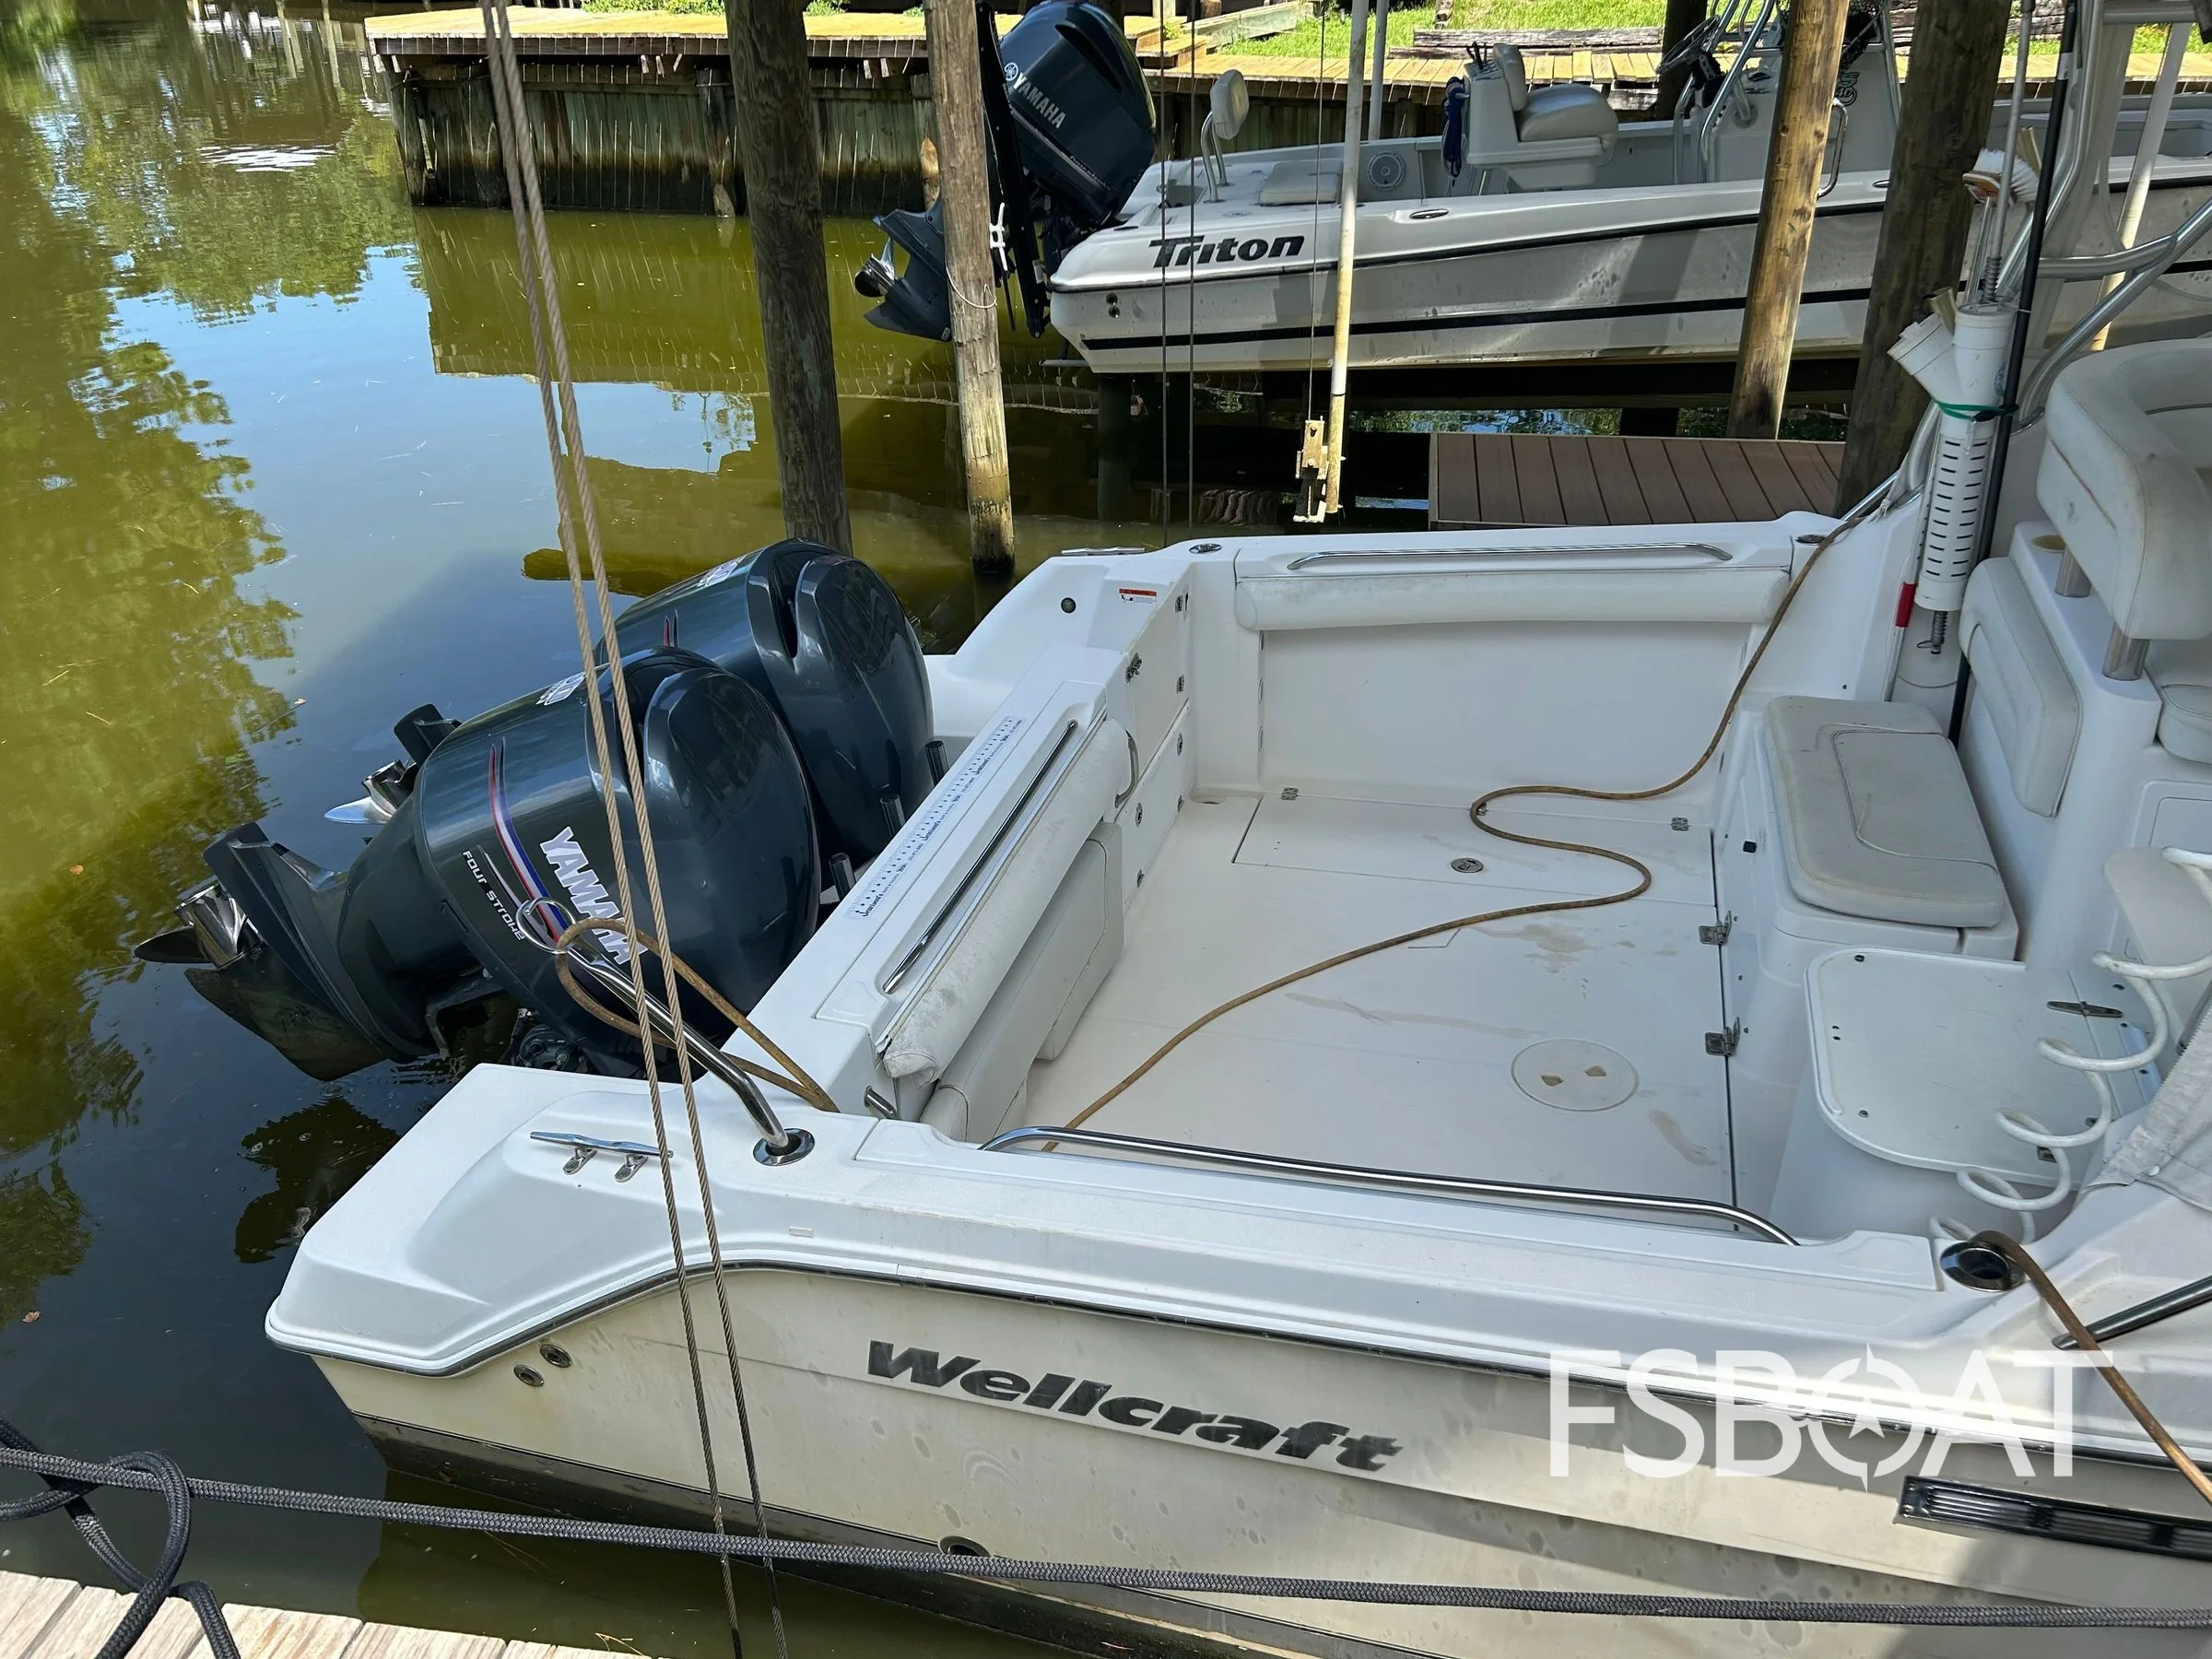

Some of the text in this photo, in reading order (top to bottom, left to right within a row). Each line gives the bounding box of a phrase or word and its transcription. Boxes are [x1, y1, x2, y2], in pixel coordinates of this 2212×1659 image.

[1013, 72, 1066, 130] YAMAHA
[1148, 234, 1305, 269] Triton
[867, 1339, 1406, 1473] Wellcraft
